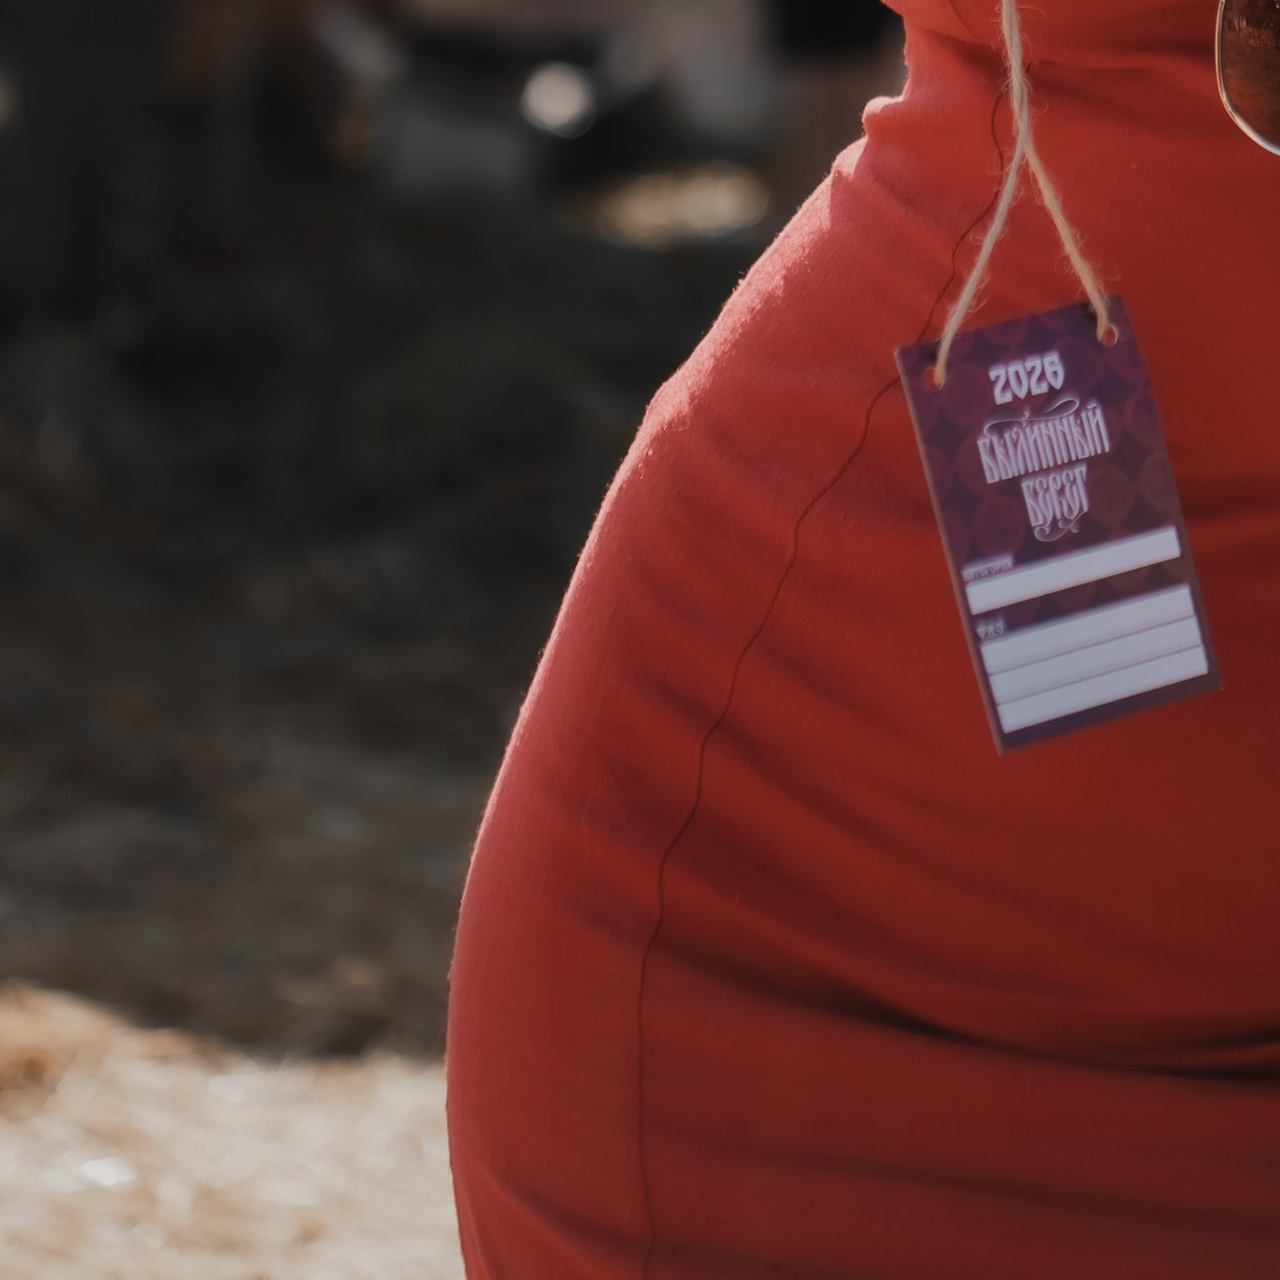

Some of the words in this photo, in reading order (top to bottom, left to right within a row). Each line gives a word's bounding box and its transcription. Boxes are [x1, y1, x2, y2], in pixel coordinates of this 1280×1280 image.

[989, 353, 1064, 405] 2026
[976, 402, 1110, 484] БЫЛИННЫЙ
[1021, 465, 1089, 528] БЕРЕГ
